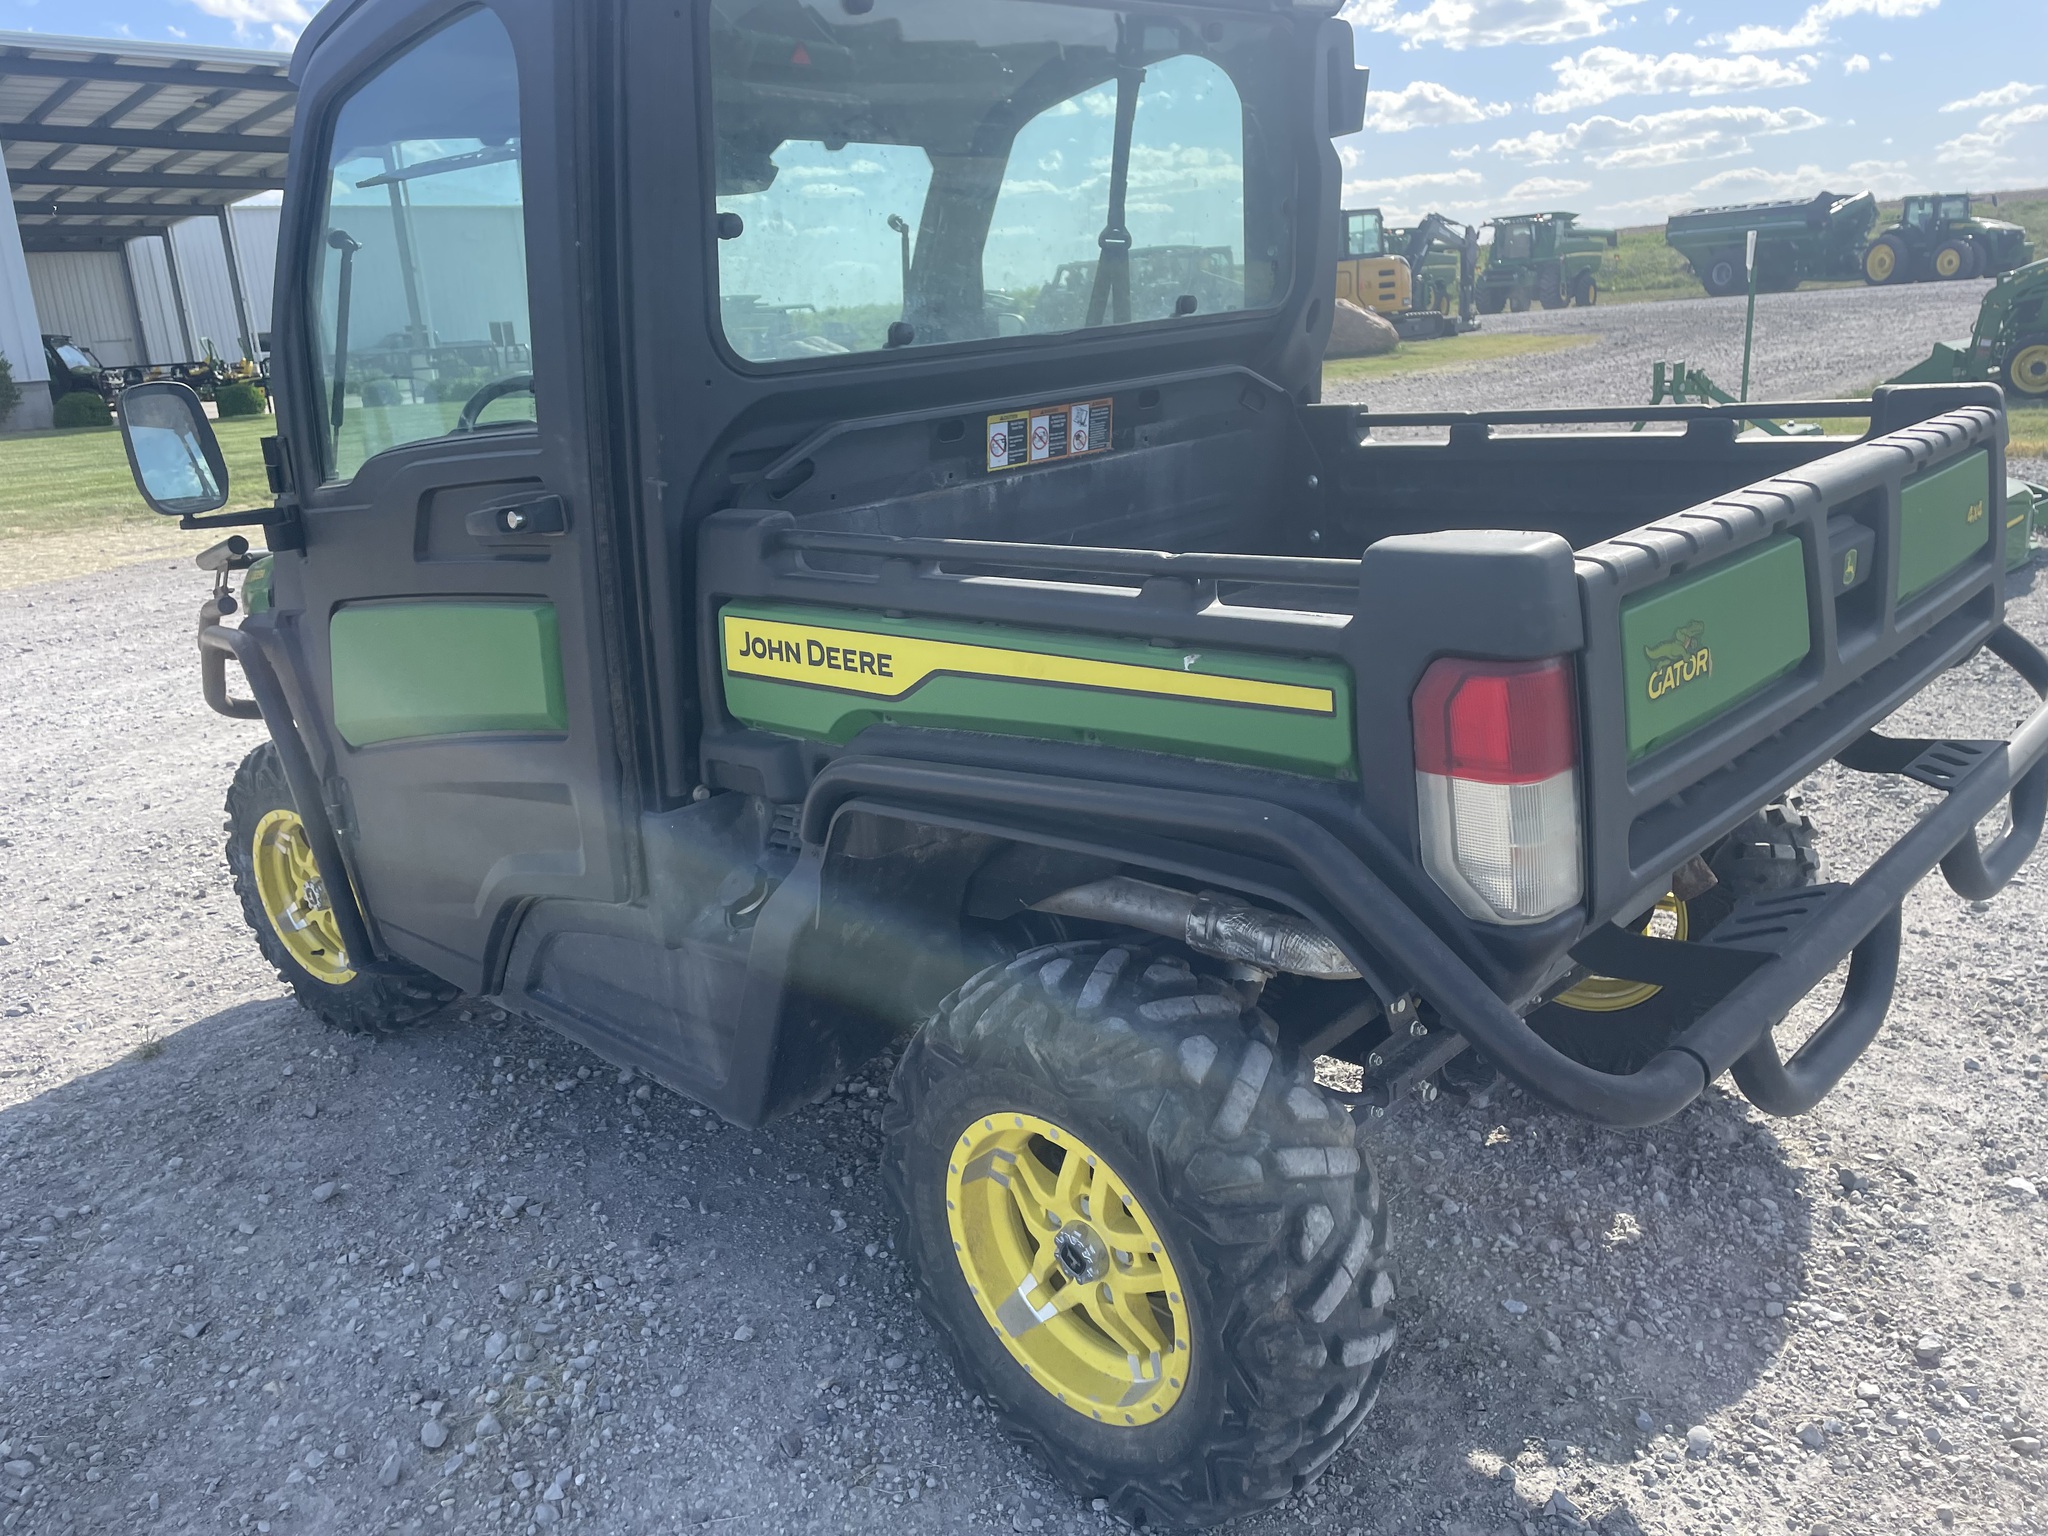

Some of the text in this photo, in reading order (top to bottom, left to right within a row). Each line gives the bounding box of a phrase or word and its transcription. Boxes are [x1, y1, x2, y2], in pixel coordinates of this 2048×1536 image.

[739, 631, 893, 678] JOHN DEERE
[1648, 647, 1709, 700] GATOR
